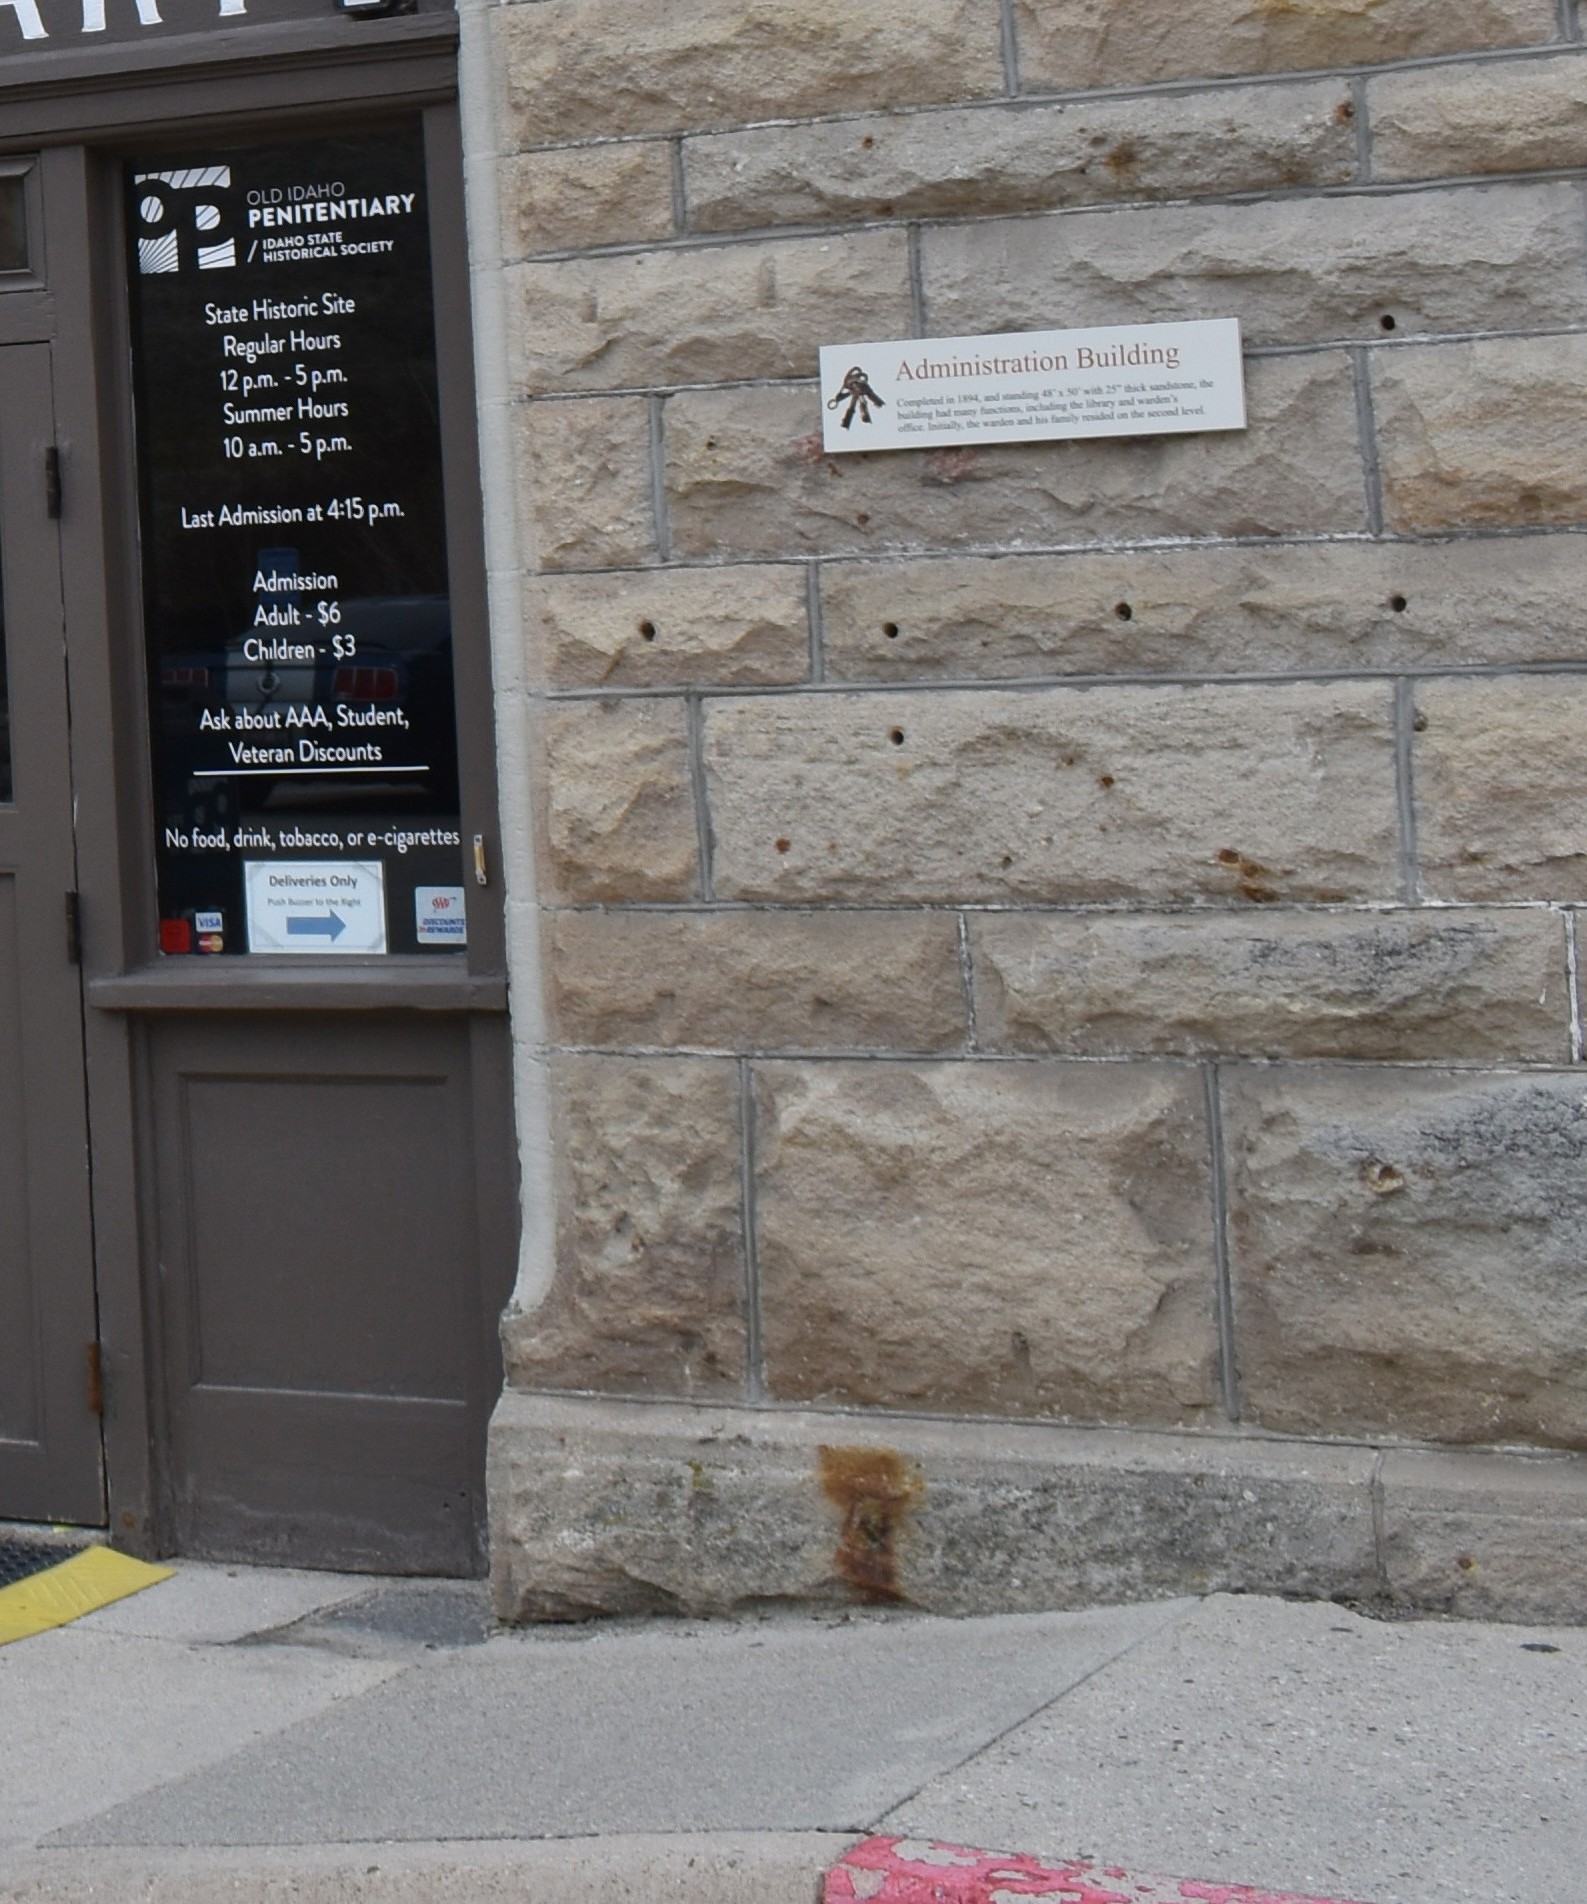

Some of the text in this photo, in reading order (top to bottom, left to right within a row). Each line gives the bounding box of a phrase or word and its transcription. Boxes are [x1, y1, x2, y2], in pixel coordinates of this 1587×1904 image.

[247, 182, 345, 206] OLD IDAHO
[249, 193, 415, 227] PENITENTIARY
[263, 232, 342, 249] IDAHO STATE
[263, 240, 394, 262] HISTORICAL SOCIETY
[205, 293, 356, 326] State Historic Site
[224, 330, 341, 364] Regular Hours
[896, 344, 1180, 381] Administration Building
[220, 364, 347, 396] 12 p.m. 5 p.m.
[897, 397, 944, 408] Completed
[985, 393, 999, 401] and
[1002, 390, 1039, 400] standing
[1084, 386, 1103, 395] with
[1125, 383, 1146, 393] thick
[1150, 381, 1197, 391] sandstone,
[1199, 379, 1214, 388] the
[224, 398, 348, 424] Summer Hours
[898, 410, 932, 420] building
[936, 409, 951, 417] had
[954, 408, 976, 417] many
[1026, 400, 1067, 412] including
[1070, 400, 1083, 409] the
[1086, 398, 1115, 409] library
[1118, 396, 1134, 406] and
[966, 420, 980, 428] the
[983, 418, 1014, 426] warden
[1017, 416, 1032, 425] and
[1035, 415, 1048, 424] his
[1051, 413, 1080, 424] family
[1082, 412, 1114, 421] resided
[1131, 410, 1144, 418] the
[1147, 407, 1179, 417] second
[223, 431, 352, 460] 10 a.m. 5 p.m.
[182, 498, 404, 528] Last Admission at 4:15 p.m.
[253, 571, 338, 592] Admission
[254, 600, 340, 627] Adult $6
[244, 634, 356, 661] Children $3
[199, 704, 409, 731] Ask about AAA, Student,
[228, 739, 382, 764] Veteran Discounts
[166, 825, 460, 853] No food, drink, tobacco, or e-cigarettes
[269, 875, 358, 889] Deliveries Only
[267, 898, 288, 906] Push
[316, 898, 324, 906] to
[326, 898, 338, 906] the
[340, 897, 361, 907] Right
[199, 916, 221, 929] VISA
